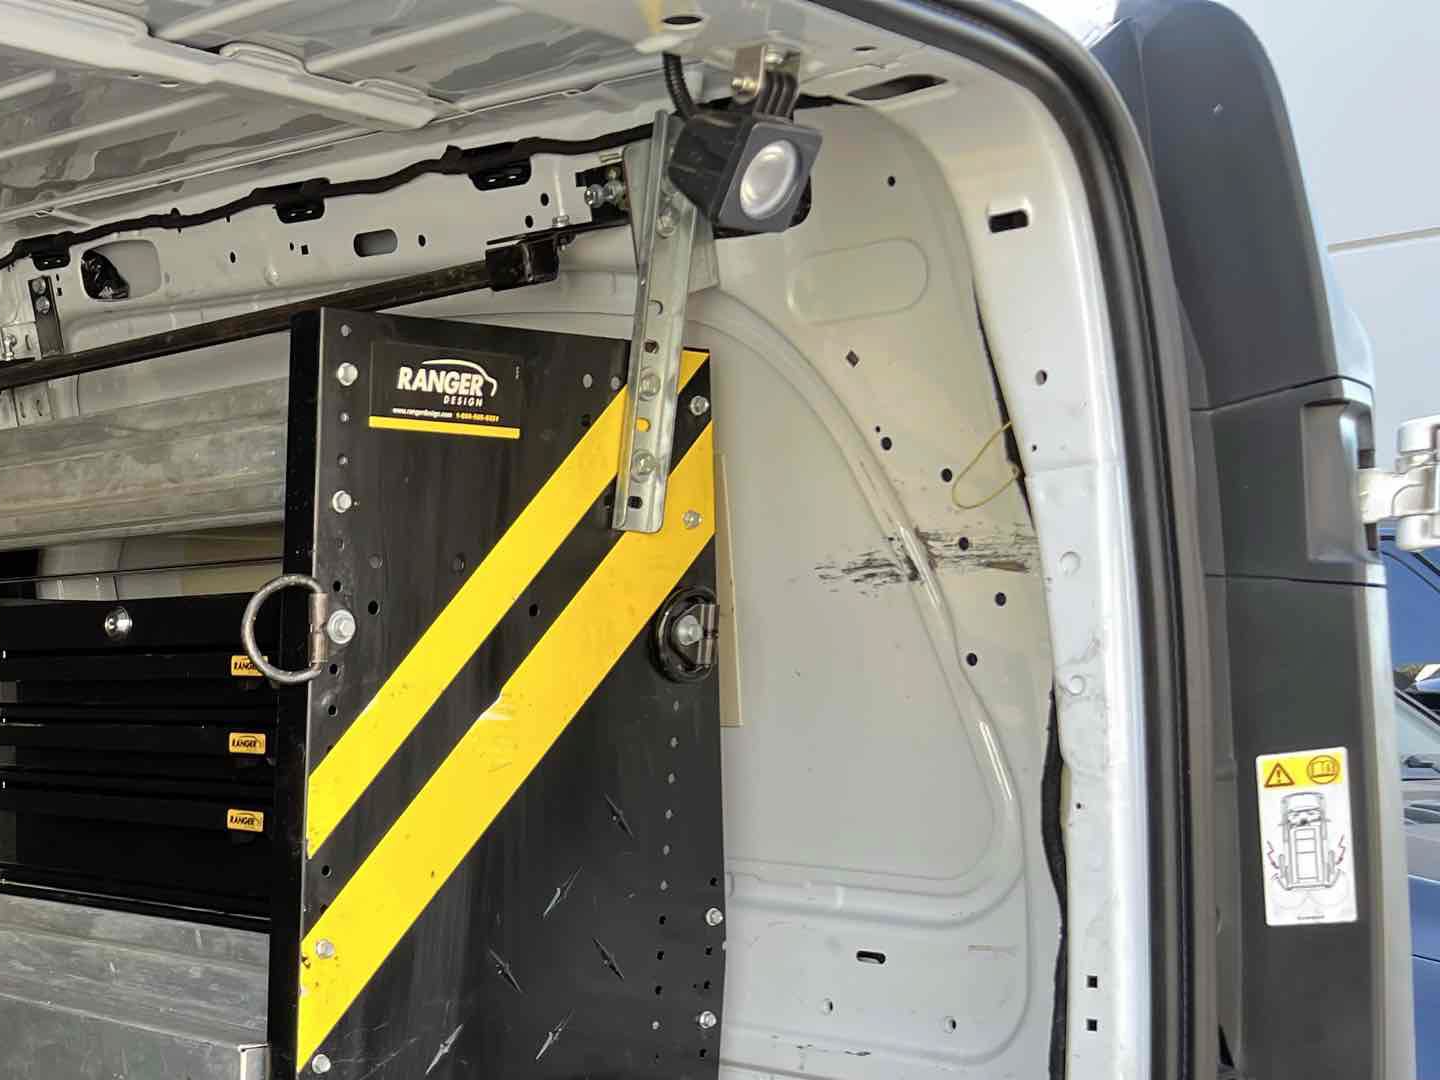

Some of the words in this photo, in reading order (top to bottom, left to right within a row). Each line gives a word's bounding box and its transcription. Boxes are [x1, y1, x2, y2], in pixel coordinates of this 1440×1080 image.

[397, 366, 484, 397] RANGER
[443, 395, 484, 408] DESIGN
[232, 738, 257, 748] RANGER
[230, 815, 256, 825] RANGER
